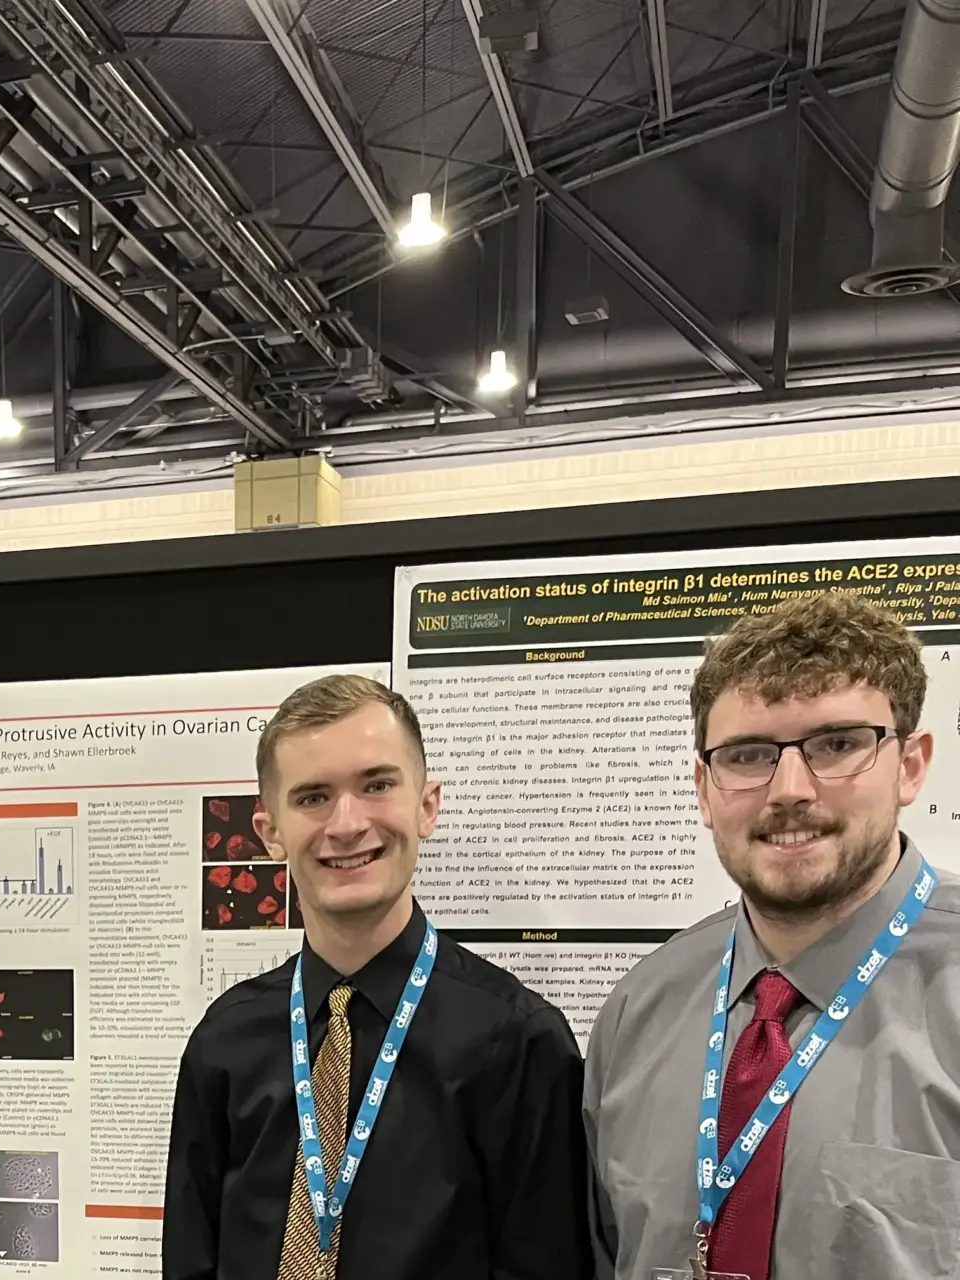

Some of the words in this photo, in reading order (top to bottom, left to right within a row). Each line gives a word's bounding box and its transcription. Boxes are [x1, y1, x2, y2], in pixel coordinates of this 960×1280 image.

[417, 589, 446, 604] The
[451, 584, 530, 601] activation
[535, 582, 586, 596] status
[591, 579, 609, 594] of
[613, 576, 678, 594] integrin
[683, 573, 703, 592] β1
[710, 570, 809, 587] determines
[814, 568, 843, 583] the
[847, 564, 899, 580] ACE2
[642, 596, 660, 607] Md
[740, 591, 768, 600] Hum
[895, 583, 922, 595] Riya
[924, 582, 933, 592] J
[591, 612, 604, 622] of
[605, 607, 691, 621] Pharmaceutical
[693, 606, 747, 617] Sciences,
[931, 609, 956, 620] Yale
[417, 615, 450, 632] NDSU
[451, 614, 473, 622] NORTH
[473, 613, 499, 621] DAKOTA
[451, 621, 469, 630] STATE
[470, 619, 506, 629] UNIVERSITY
[525, 650, 585, 663] Background
[941, 651, 951, 662] A
[82, 721, 146, 740] Activity
[152, 720, 166, 735] in
[172, 717, 239, 735] Ovarian
[1, 751, 30, 761] Reyes,
[32, 748, 50, 758] and
[53, 748, 84, 758] Shawn
[87, 745, 136, 756] Ellerbroek
[12, 764, 45, 772] Waverly,
[467, 806, 558, 817] Angiotensin-converting
[561, 804, 592, 815] Enzyme
[595, 804, 600, 813] 2
[603, 803, 631, 814] (ACE2)
[634, 804, 641, 812] is
[644, 803, 671, 812] known
[674, 802, 686, 812] for
[688, 801, 699, 811] its
[929, 804, 938, 814] B
[425, 865, 432, 873] is
[434, 865, 442, 873] to
[445, 864, 460, 873] find
[462, 864, 475, 873] the
[477, 864, 513, 872] influence
[515, 863, 524, 872] of
[526, 864, 538, 872] the
[541, 863, 590, 872] extracellular
[592, 863, 617, 871] matrix
[634, 862, 646, 871] the
[649, 862, 694, 872] expression
[419, 878, 450, 887] function
[455, 878, 464, 887] of
[468, 878, 489, 887] ACE2
[494, 878, 502, 886] in
[506, 878, 519, 887] the
[524, 878, 550, 888] kidney.
[556, 878, 568, 886] We
[574, 877, 627, 887] hypothesized
[632, 877, 647, 886] that
[652, 877, 665, 885] the
[670, 876, 693, 885] ACE2
[522, 931, 558, 941] Method
